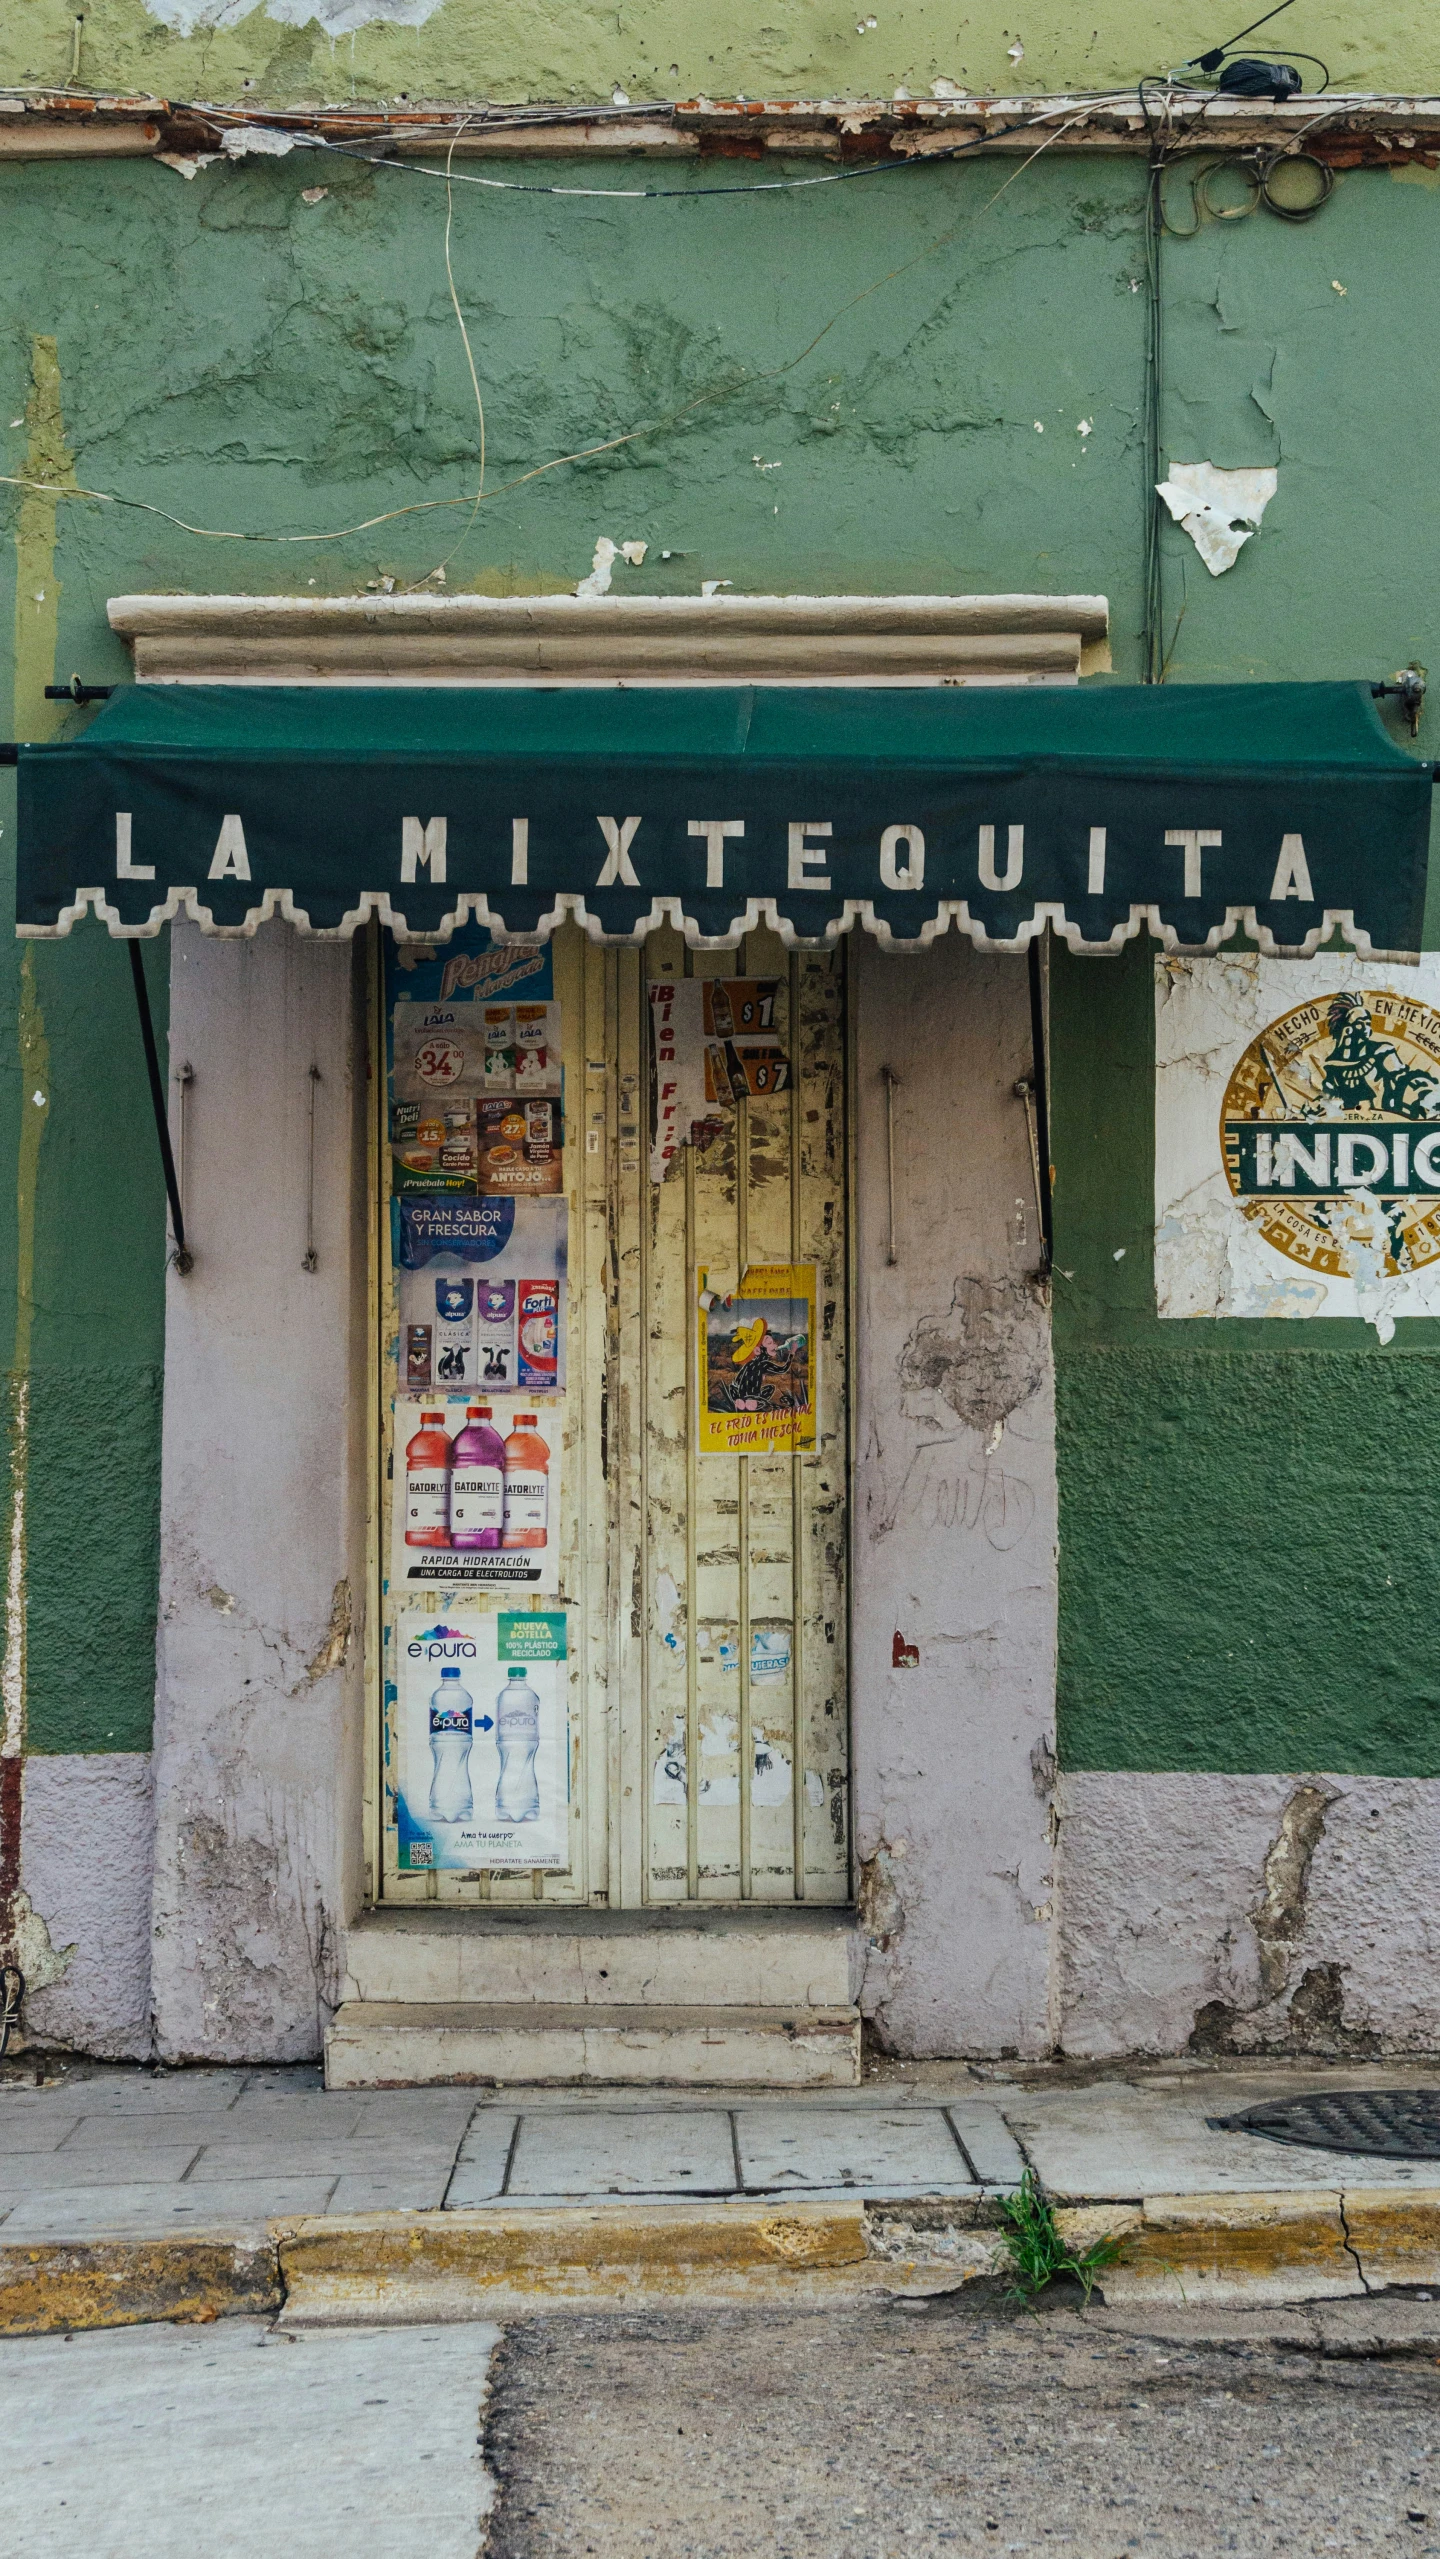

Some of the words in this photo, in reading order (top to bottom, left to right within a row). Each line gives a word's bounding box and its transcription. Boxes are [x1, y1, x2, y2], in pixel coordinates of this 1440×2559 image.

[115, 812, 251, 882] LA
[400, 816, 1315, 902] MIXTEQUITA
[423, 1013, 455, 1026] LALA
[1274, 1007, 1320, 1042] HECHO
[1375, 1000, 1394, 1016] EN
[1397, 1004, 1440, 1039] MEXIC
[396, 1103, 421, 1116] Nutri
[400, 1112, 419, 1124] Deli
[1344, 1113, 1384, 1121] ERVZA
[403, 1179, 445, 1188] ¡Pruébalo
[446, 1180, 466, 1188] Hoy!
[411, 1210, 452, 1222] GRAN
[455, 1210, 502, 1222] SABOR
[1273, 1203, 1285, 1216] LA
[1286, 1216, 1311, 1238] COSA
[1314, 1233, 1328, 1244] ES
[416, 1224, 424, 1236] Y
[428, 1224, 498, 1236] FRESCURA
[430, 1239, 497, 1247] CONSERVADORES
[525, 1296, 552, 1308] Forti
[709, 1422, 722, 1434] EL
[726, 1413, 752, 1430] FRÍO
[755, 1412, 768, 1425] ES
[728, 1430, 757, 1447] TOMA
[760, 1421, 802, 1440] MEZCAL
[454, 1482, 500, 1492] GATORLYTE
[421, 1555, 459, 1565] RAPIDA
[462, 1555, 531, 1567] HIDRATACIÓN
[437, 1569, 462, 1577] CARGA
[476, 1570, 528, 1578] ELECTROLITOS
[513, 1622, 549, 1631] NUEVA
[510, 1630, 552, 1639] BOTELLA
[505, 1641, 523, 1649] 100%
[524, 1640, 558, 1649] PLÁSTICO
[511, 1649, 551, 1657] RECICLADO
[461, 1831, 476, 1839] Ama
[454, 1840, 474, 1848] AMA
[476, 1840, 486, 1848] TU
[488, 1840, 523, 1848] PLANETA
